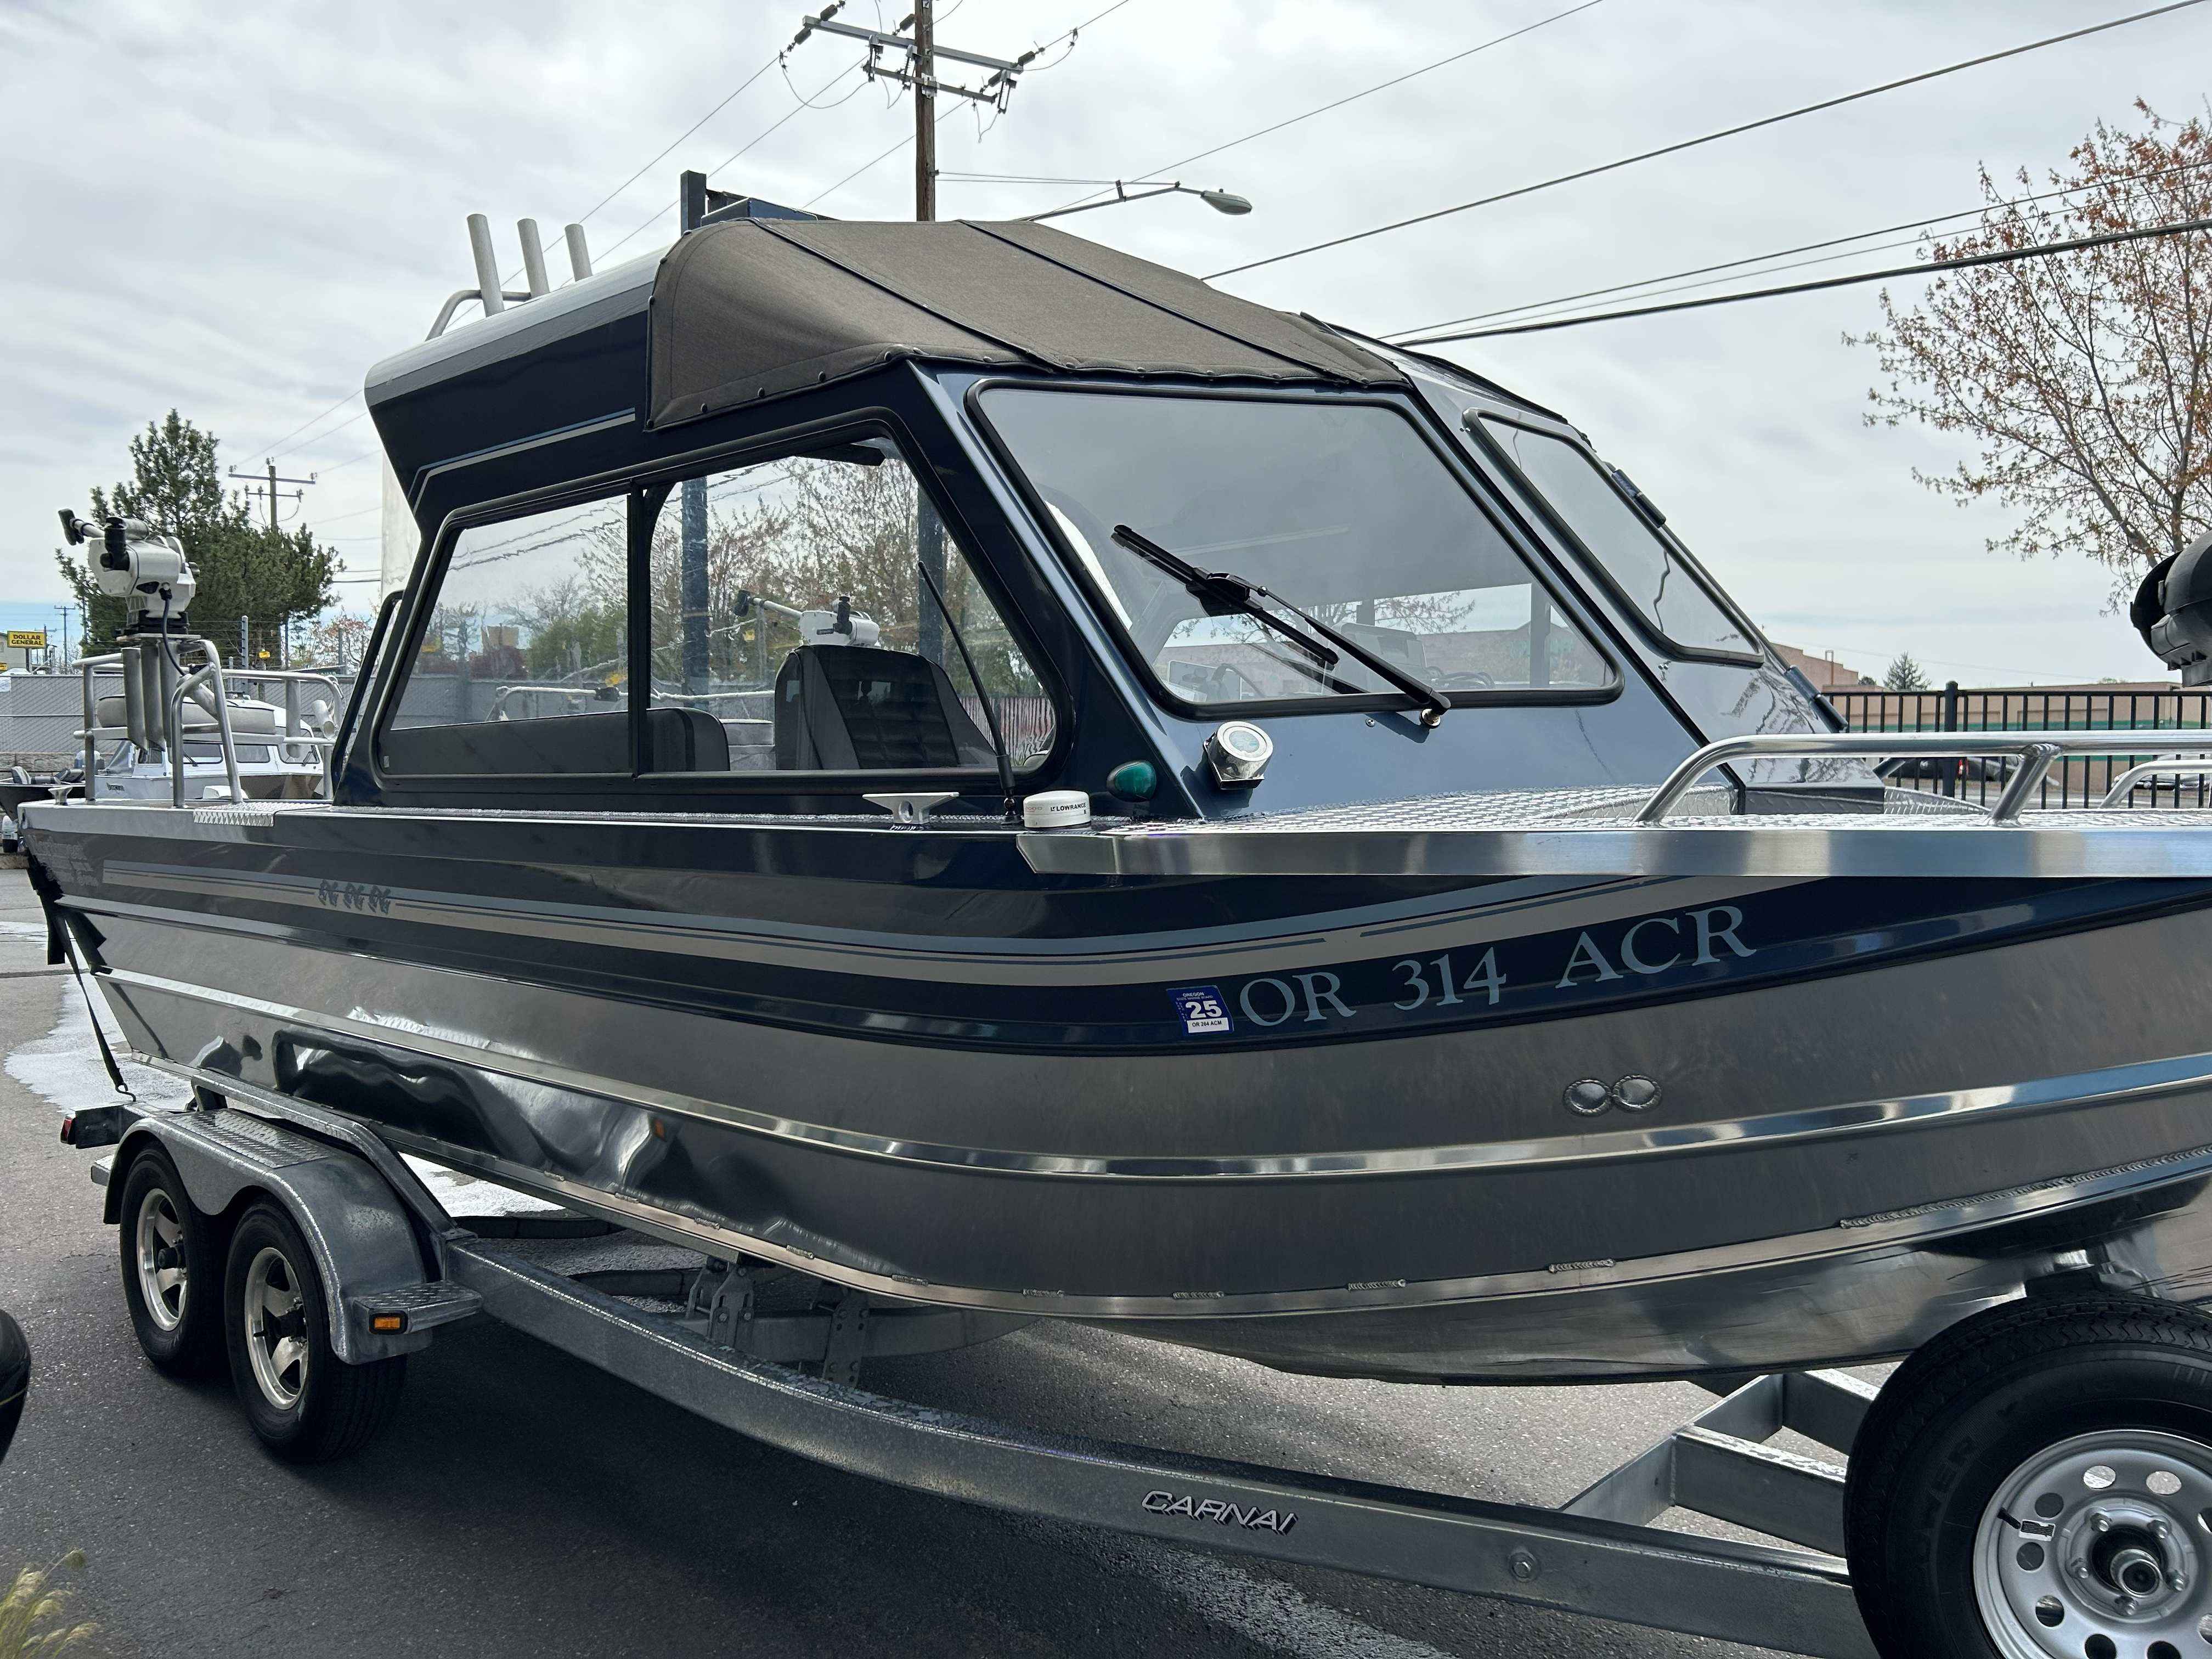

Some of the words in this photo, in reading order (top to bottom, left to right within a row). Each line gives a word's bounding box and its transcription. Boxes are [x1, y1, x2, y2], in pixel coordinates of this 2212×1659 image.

[1056, 803, 1086, 811] LOWRANCE
[1239, 972, 1357, 1028] OR
[1391, 946, 1507, 1011] 314
[1555, 905, 1757, 990] ACR
[1185, 1000, 1222, 1019] 25
[1142, 1490, 1299, 1536] CARNAI
